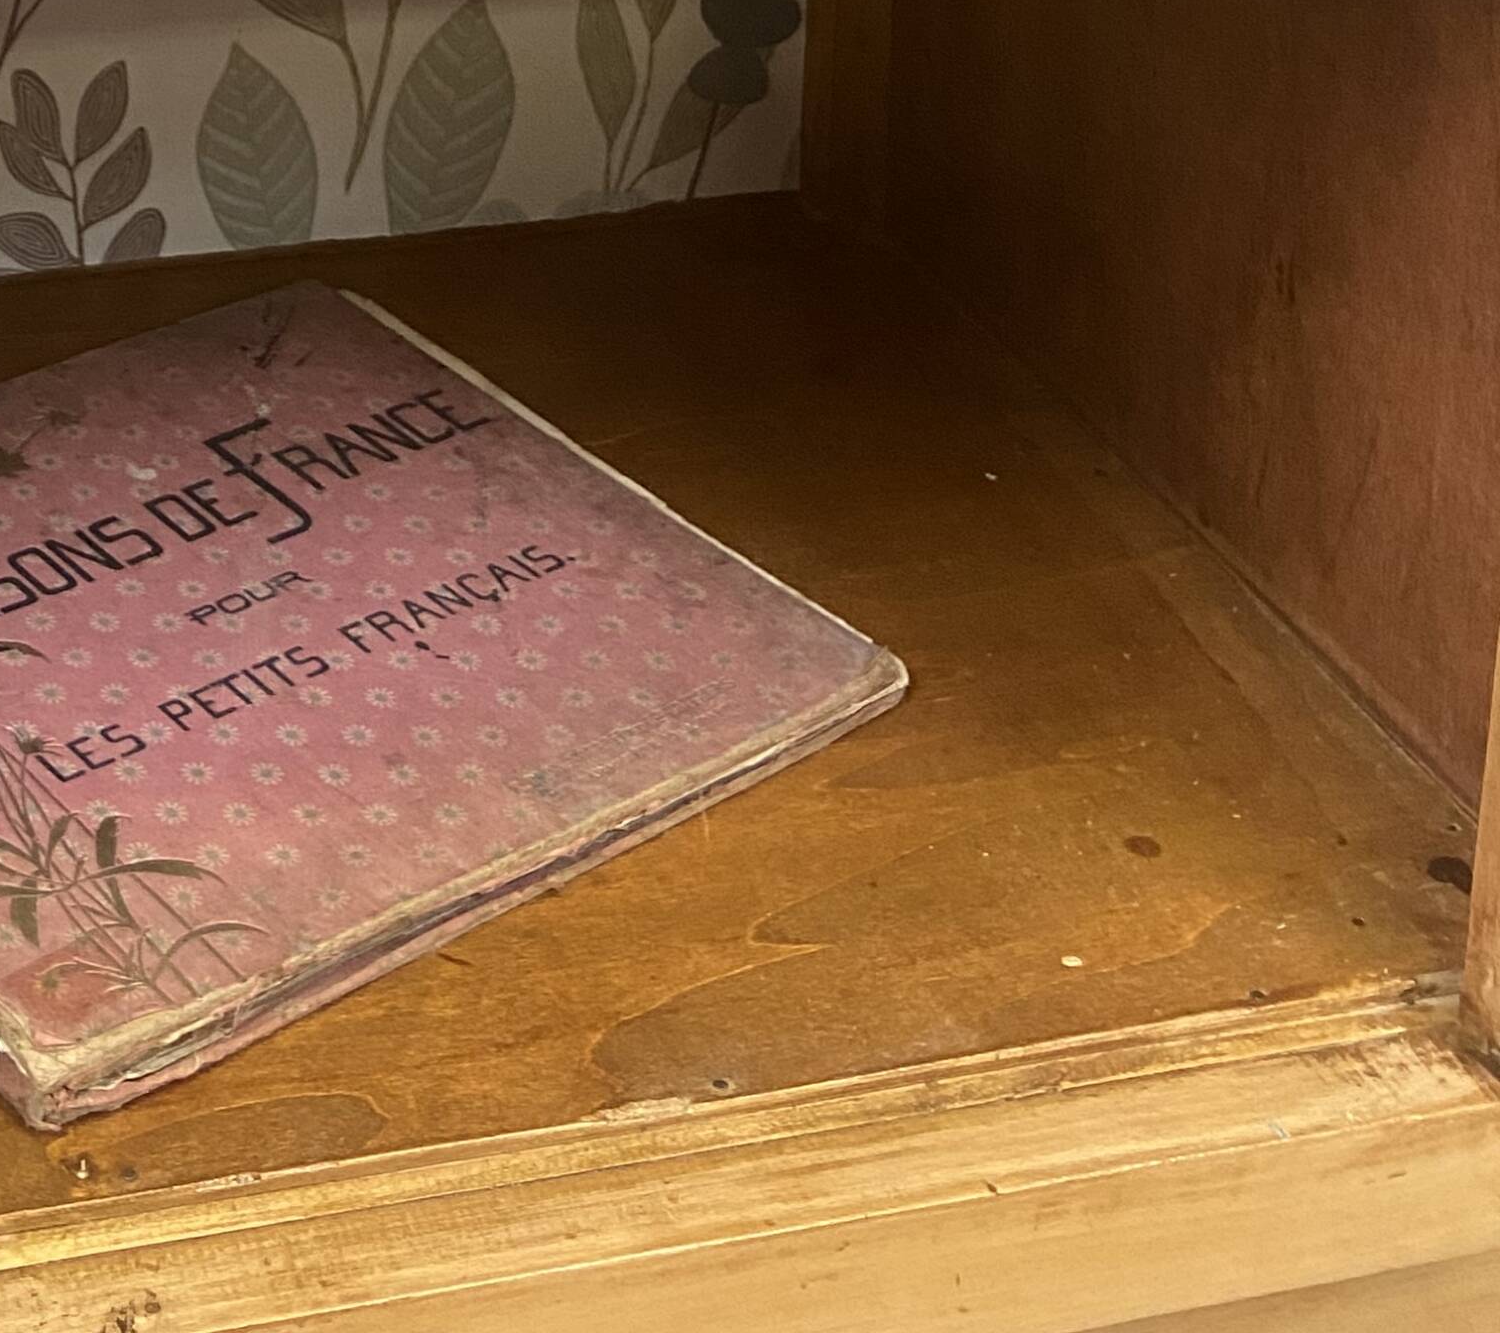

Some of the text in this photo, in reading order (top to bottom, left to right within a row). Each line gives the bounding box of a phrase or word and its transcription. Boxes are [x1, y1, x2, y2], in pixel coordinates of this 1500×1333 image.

[142, 477, 259, 542] DE
[204, 388, 495, 544] FRANCE
[28, 541, 580, 785] LES PETITS FRANÇAIS.
[184, 569, 314, 627] POUR
